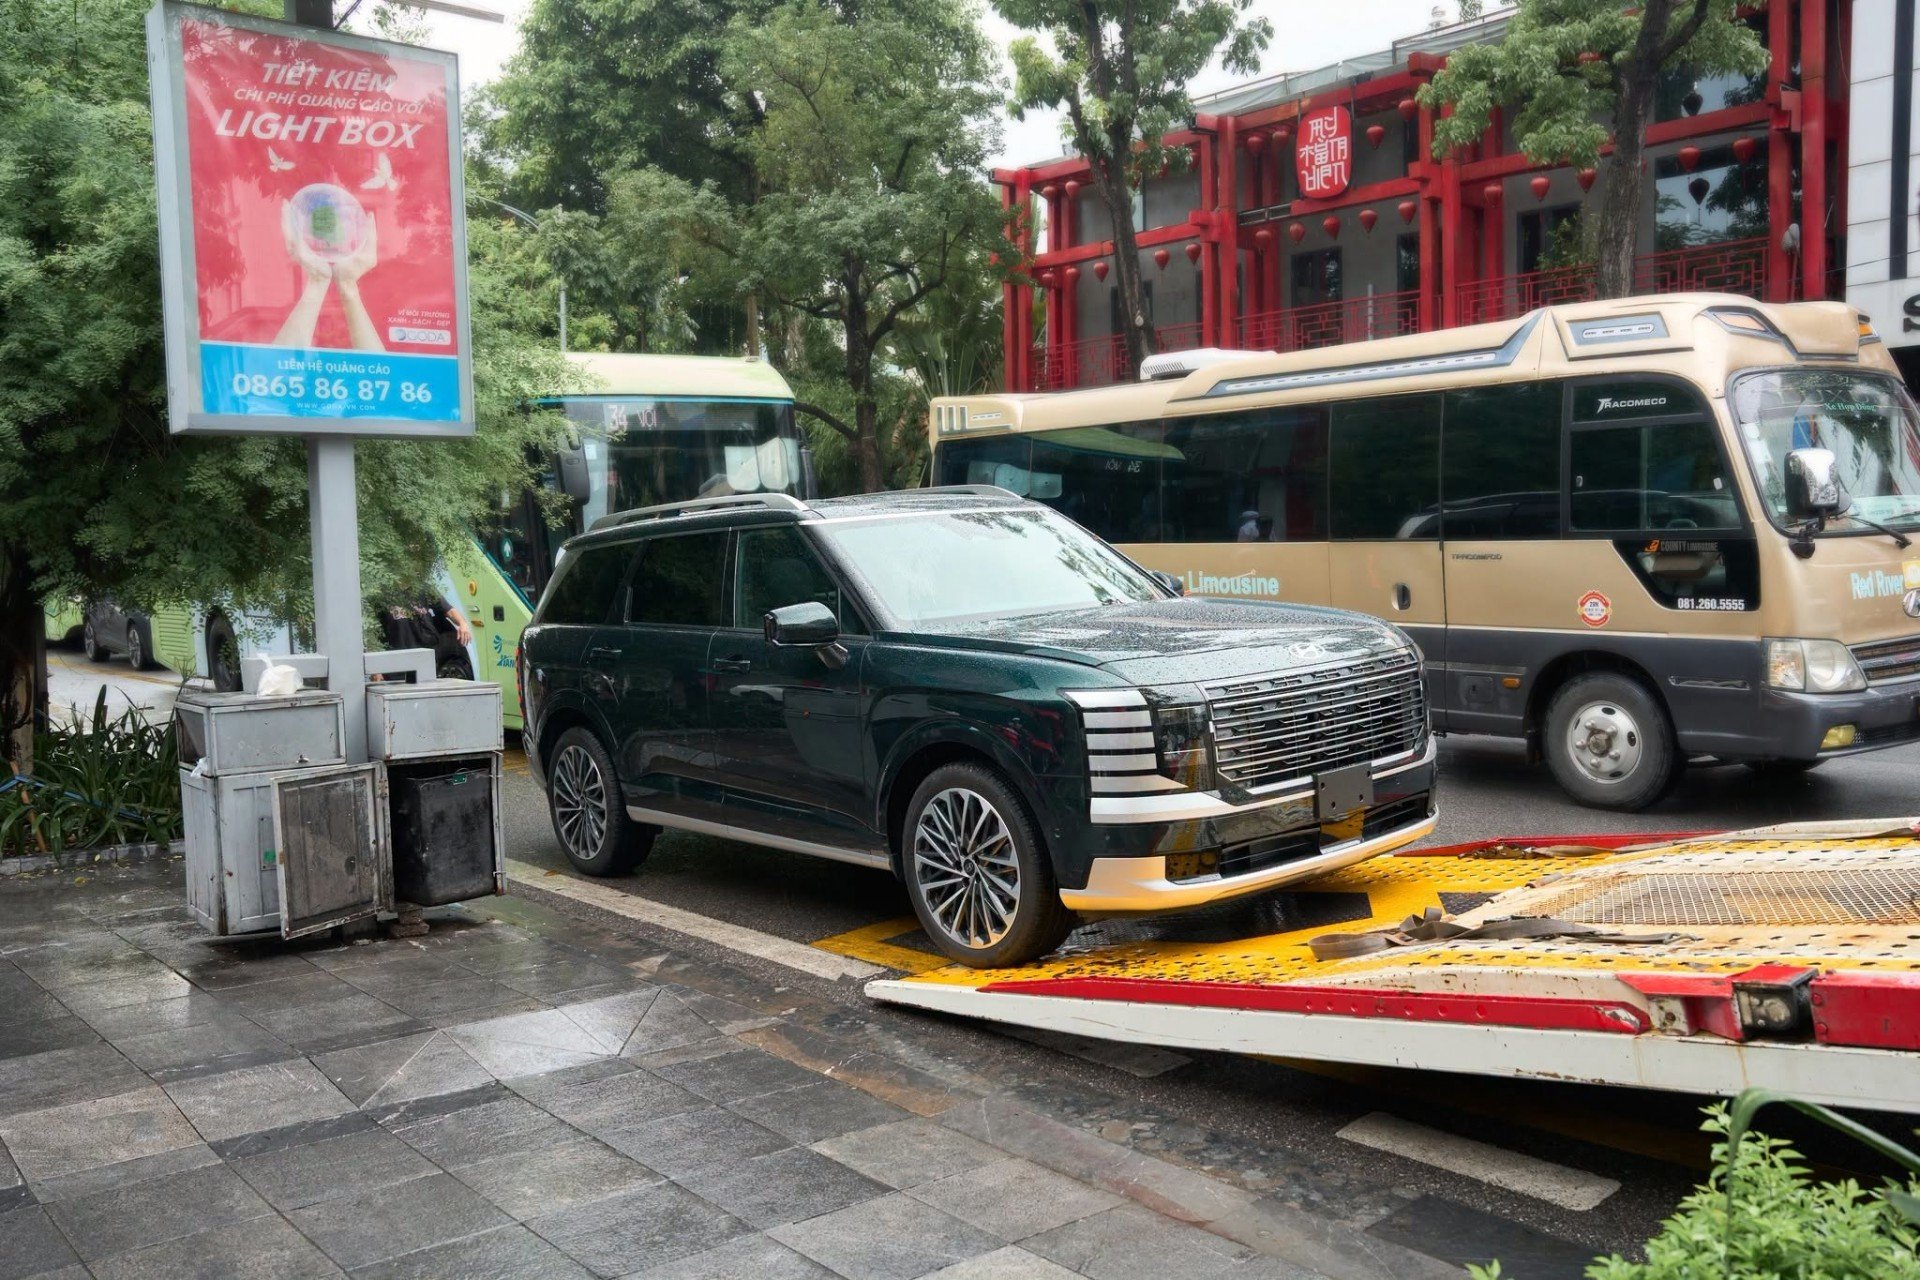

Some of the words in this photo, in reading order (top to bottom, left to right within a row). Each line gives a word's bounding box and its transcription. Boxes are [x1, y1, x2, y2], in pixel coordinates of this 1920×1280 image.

[324, 68, 398, 97] KIỆM
[233, 88, 262, 101] CHI
[265, 90, 297, 106] PHÍ
[298, 92, 356, 110] QUẢNG
[215, 109, 337, 144] LIGHT
[338, 118, 424, 149] BOX
[277, 358, 305, 371] LIÊN
[307, 359, 323, 374] HỆ
[325, 361, 366, 375] QUẢNG
[368, 363, 391, 375] CÁO
[232, 373, 306, 398] 0865
[314, 377, 349, 401] 86
[357, 379, 391, 402] 87
[400, 381, 432, 404] 86
[608, 403, 629, 431] 34
[1597, 397, 1667, 414] TRACOMECO
[1187, 570, 1280, 595] Limousine
[1850, 571, 1875, 600] Red
[1875, 570, 1904, 598] River
[1677, 597, 1745, 611] 081.260.5555
